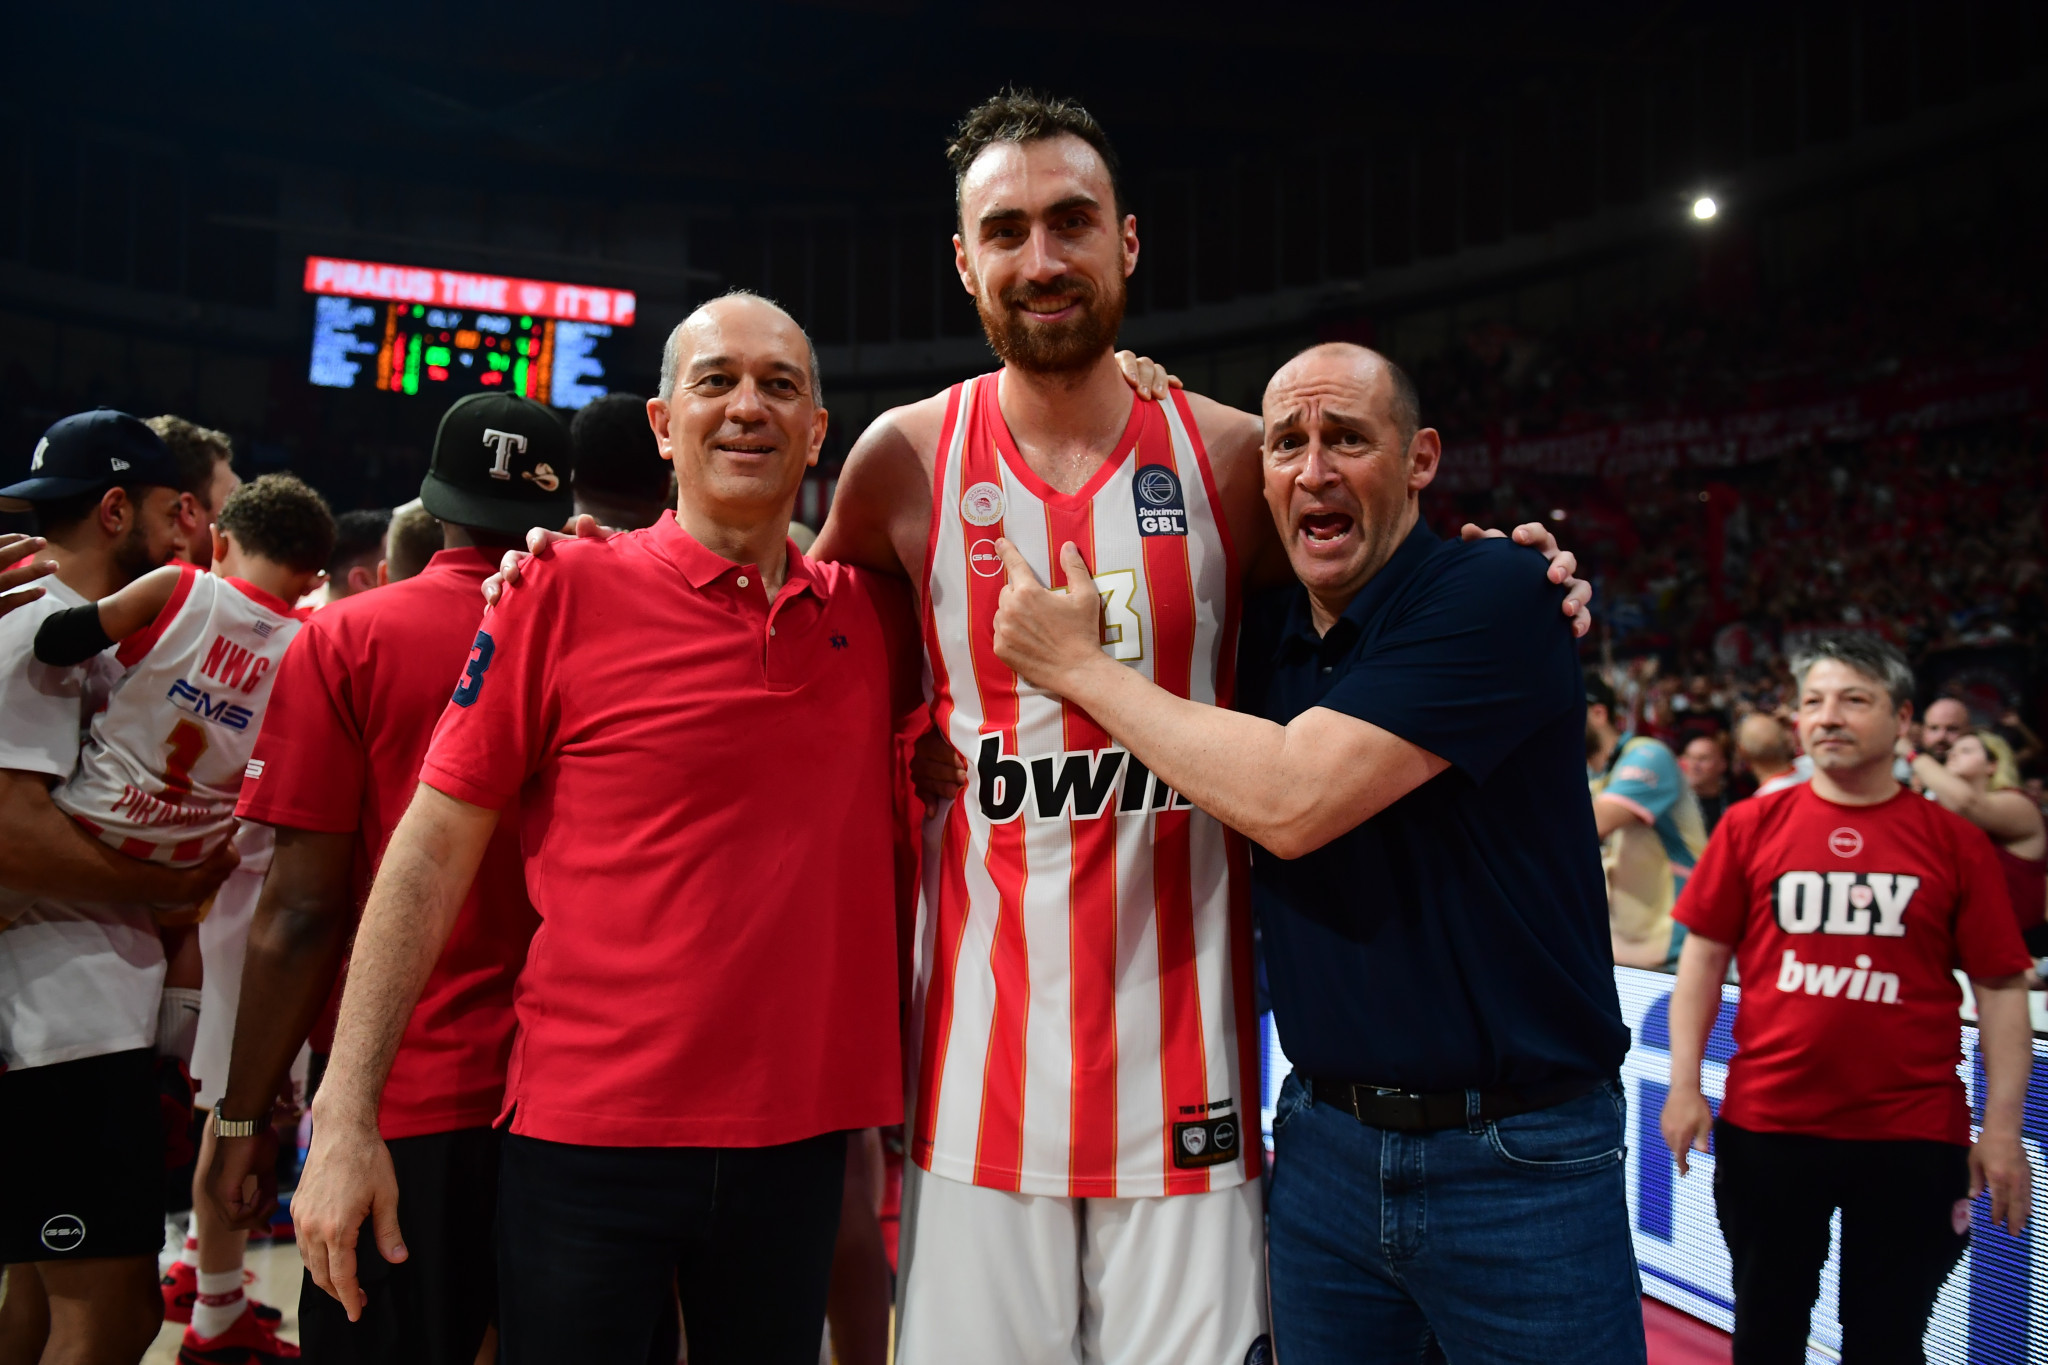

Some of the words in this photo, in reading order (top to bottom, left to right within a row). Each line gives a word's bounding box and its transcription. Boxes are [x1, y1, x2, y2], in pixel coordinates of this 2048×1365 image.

[314, 260, 434, 302] PIRAEUS
[440, 272, 509, 310] TIME
[482, 428, 527, 480] T
[1138, 507, 1184, 517] Stoiximan
[1141, 517, 1185, 533] GBL
[972, 553, 1001, 562] GSA
[200, 634, 270, 695] NWG
[166, 678, 254, 731] FMS
[158, 718, 209, 805] 1
[1778, 871, 1921, 937] OLY
[1776, 949, 1900, 1005] bwin
[45, 1228, 82, 1236] GSA
